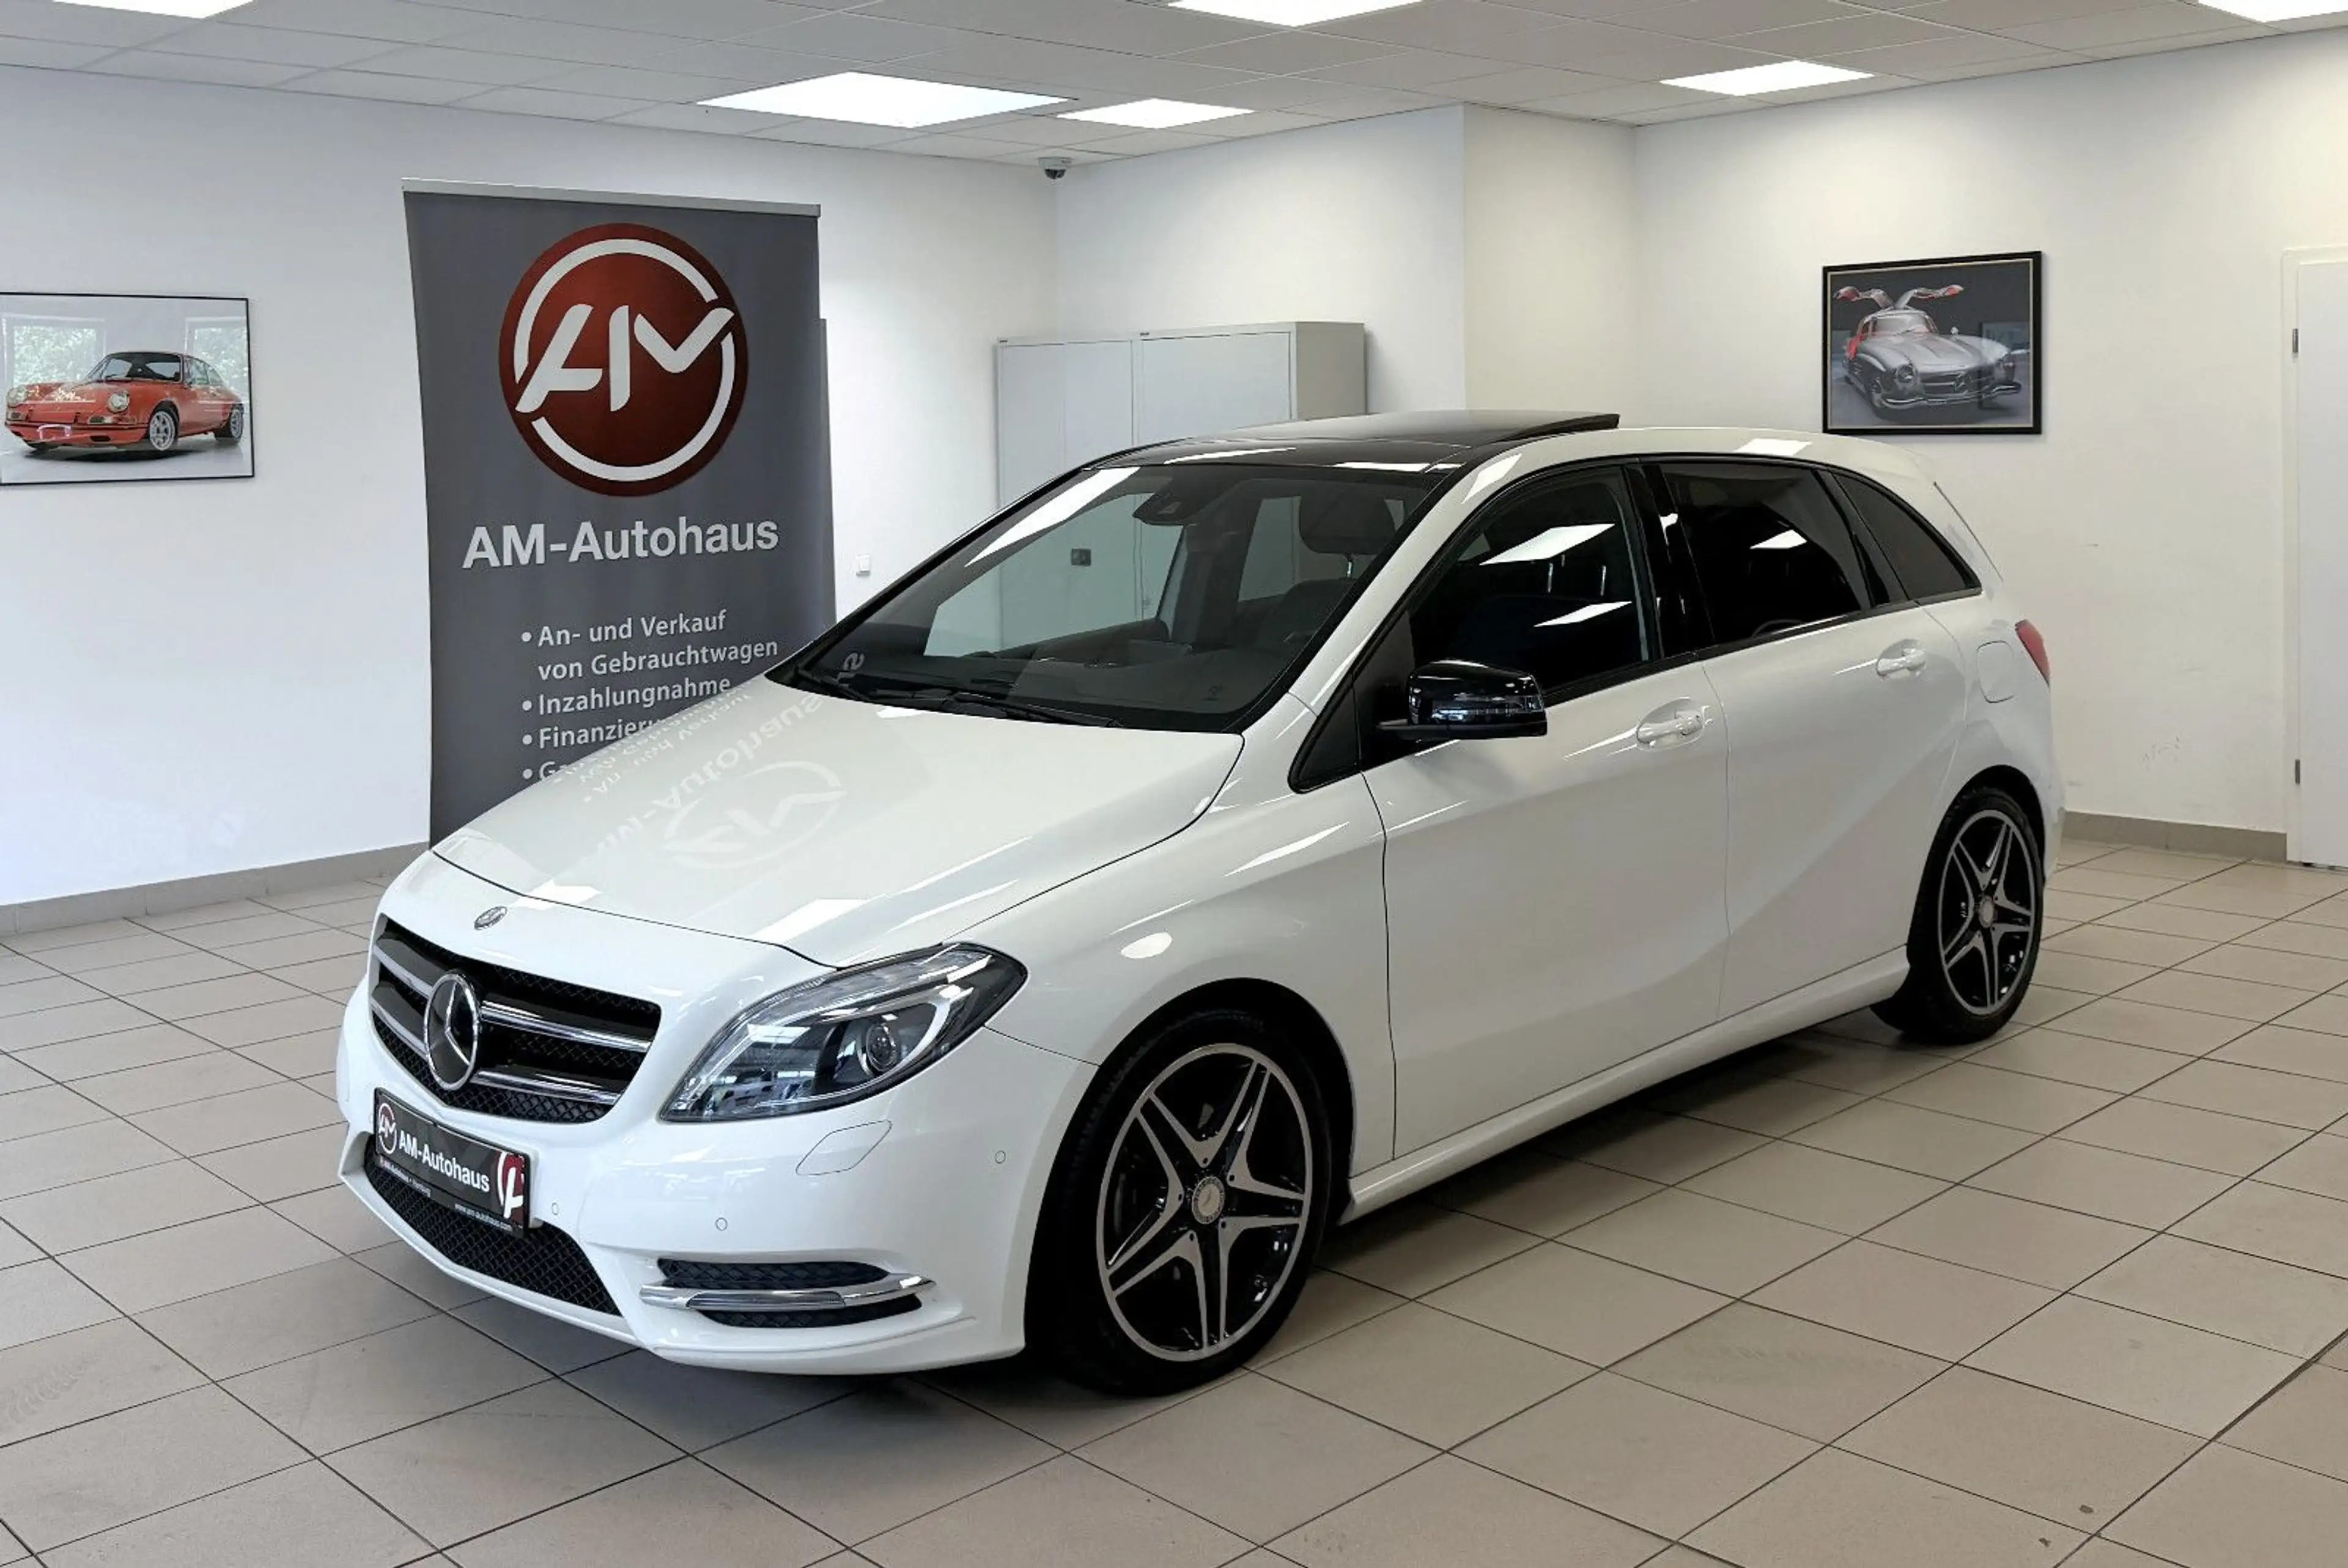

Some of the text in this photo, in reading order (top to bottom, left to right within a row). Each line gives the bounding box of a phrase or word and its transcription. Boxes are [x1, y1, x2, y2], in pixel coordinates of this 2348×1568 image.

[515, 303, 735, 413] AM
[462, 516, 780, 569] AM-Autohaus
[537, 609, 728, 648] An- und Verkauf
[537, 639, 778, 682] von Gebrauchtwagen
[538, 677, 731, 715] Inzahlungnahme
[539, 718, 659, 749] Finanzier
[399, 1130, 490, 1193] AM-Autohaus
